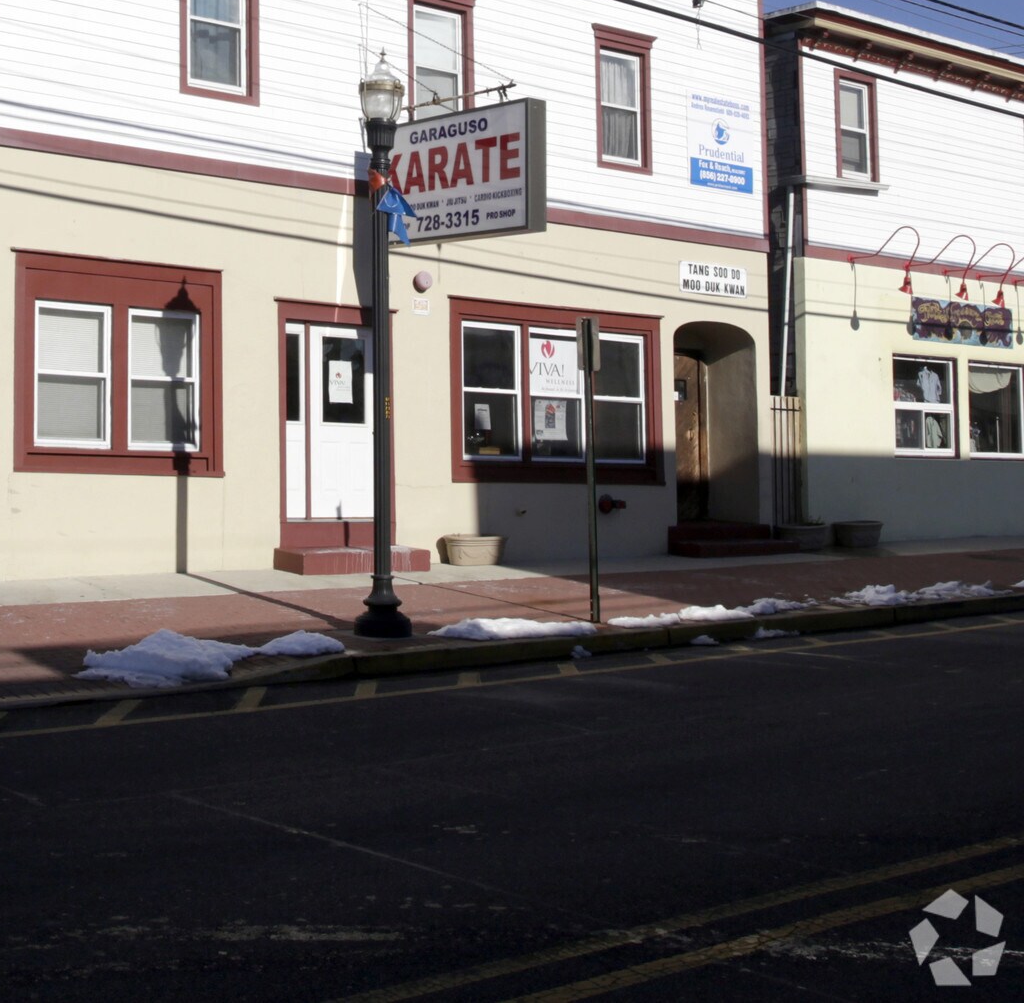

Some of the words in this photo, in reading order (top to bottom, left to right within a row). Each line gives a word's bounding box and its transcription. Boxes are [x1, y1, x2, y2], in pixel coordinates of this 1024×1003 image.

[409, 117, 488, 145] GARAGUSO
[698, 143, 745, 163] Prudential
[388, 132, 521, 195] KARATE
[454, 197, 467, 206] JITSU
[474, 192, 492, 202] CARDIO
[492, 187, 522, 200] KICKBOXING
[416, 209, 480, 232] 728-3315
[486, 211, 498, 220] PRO
[499, 209, 516, 218] SHOP
[688, 263, 709, 276] TANG
[713, 266, 728, 279] SOO
[731, 268, 741, 280] DO
[682, 278, 701, 291] MOO
[705, 281, 720, 293] DUK
[723, 283, 745, 296] KWAN
